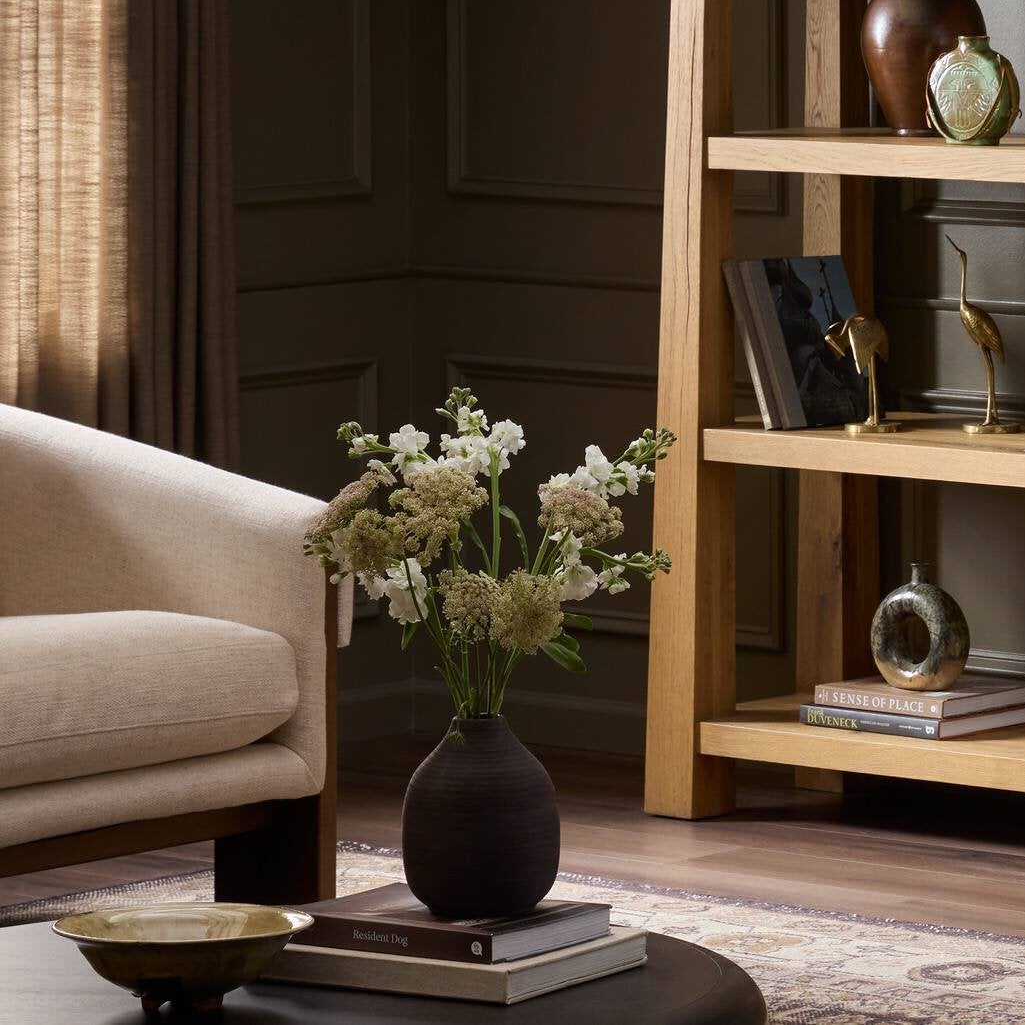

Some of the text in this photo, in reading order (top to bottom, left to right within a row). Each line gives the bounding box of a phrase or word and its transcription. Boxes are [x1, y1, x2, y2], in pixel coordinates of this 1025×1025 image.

[832, 692, 925, 713] SENSE OF PLACE
[807, 714, 858, 729] DUVENECK
[353, 929, 409, 948] Resident Dog
